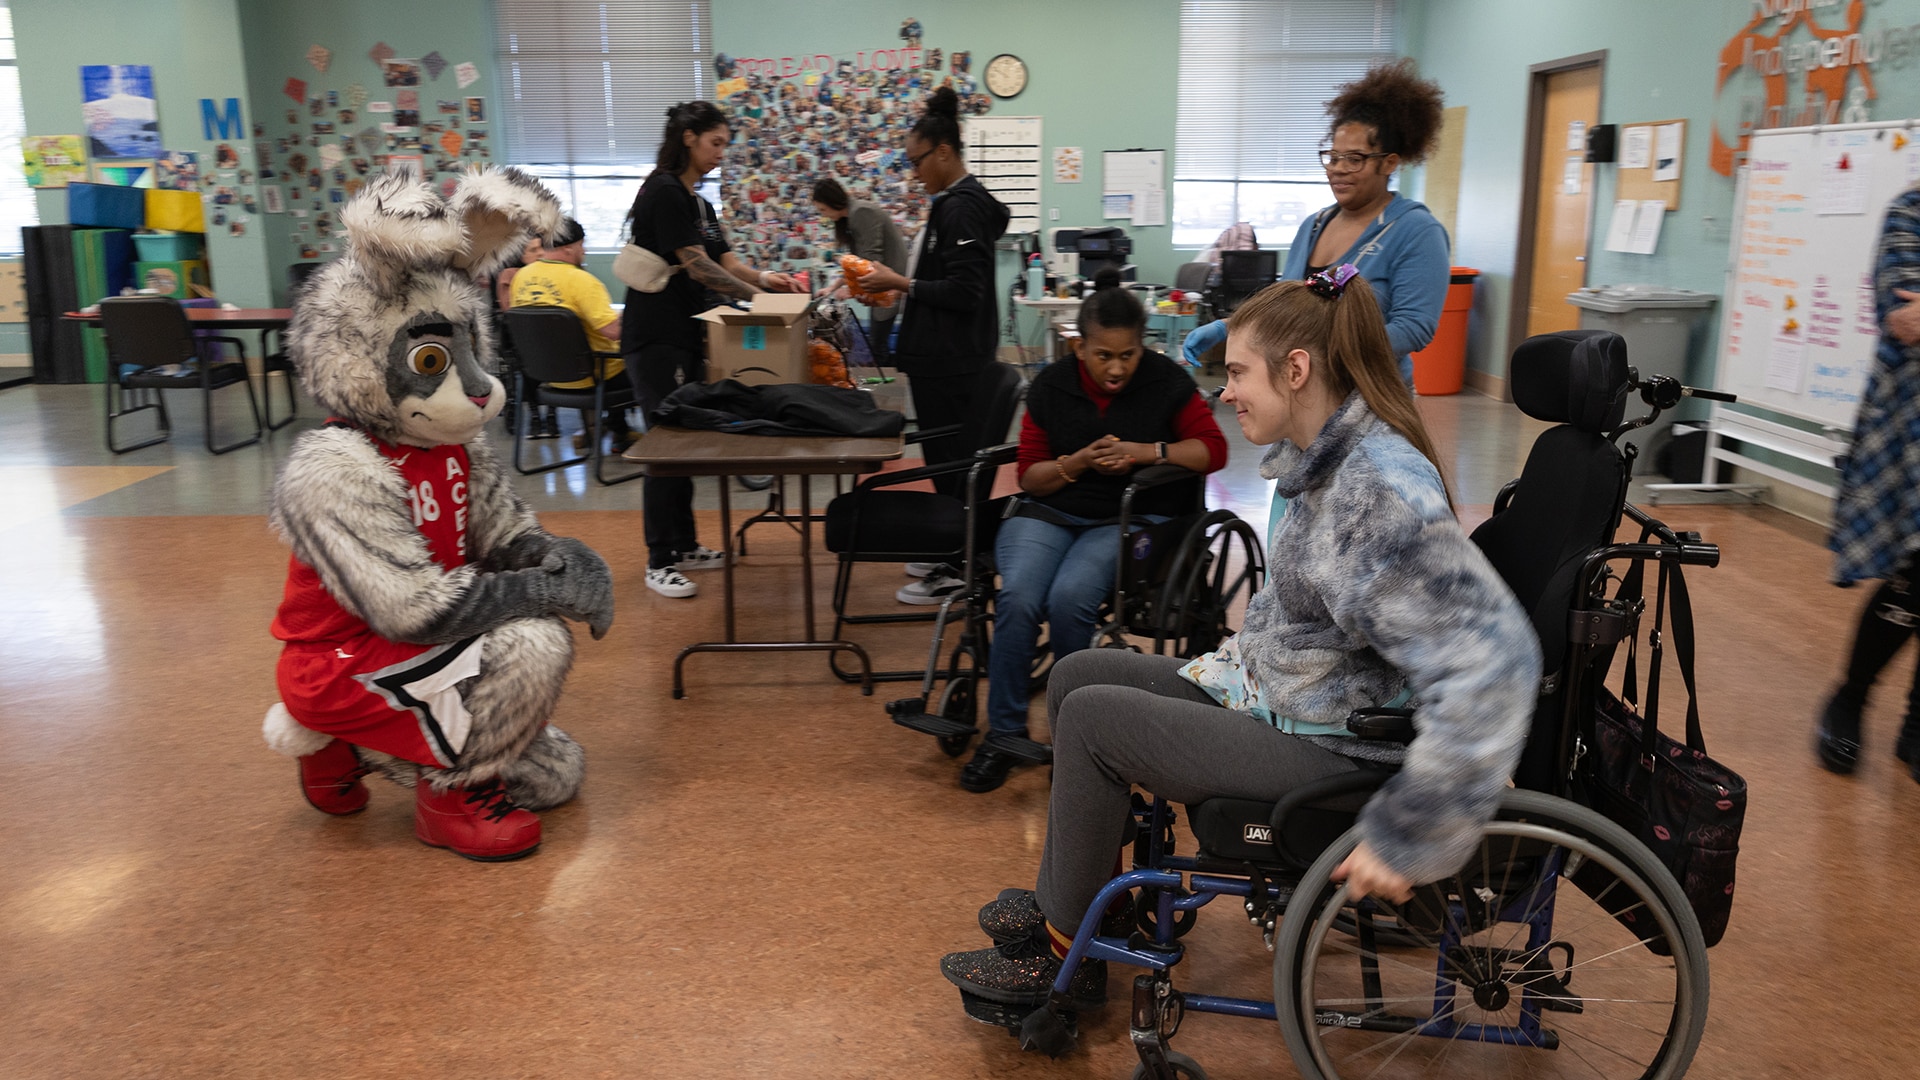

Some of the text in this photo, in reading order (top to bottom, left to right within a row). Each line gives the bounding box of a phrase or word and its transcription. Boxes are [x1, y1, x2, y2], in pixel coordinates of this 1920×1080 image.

[734, 47, 921, 79] SPREAD LOVE
[199, 98, 245, 141] M
[408, 480, 441, 527] 18
[1246, 827, 1271, 841] JAY
[1347, 1016, 1362, 1028] 2
